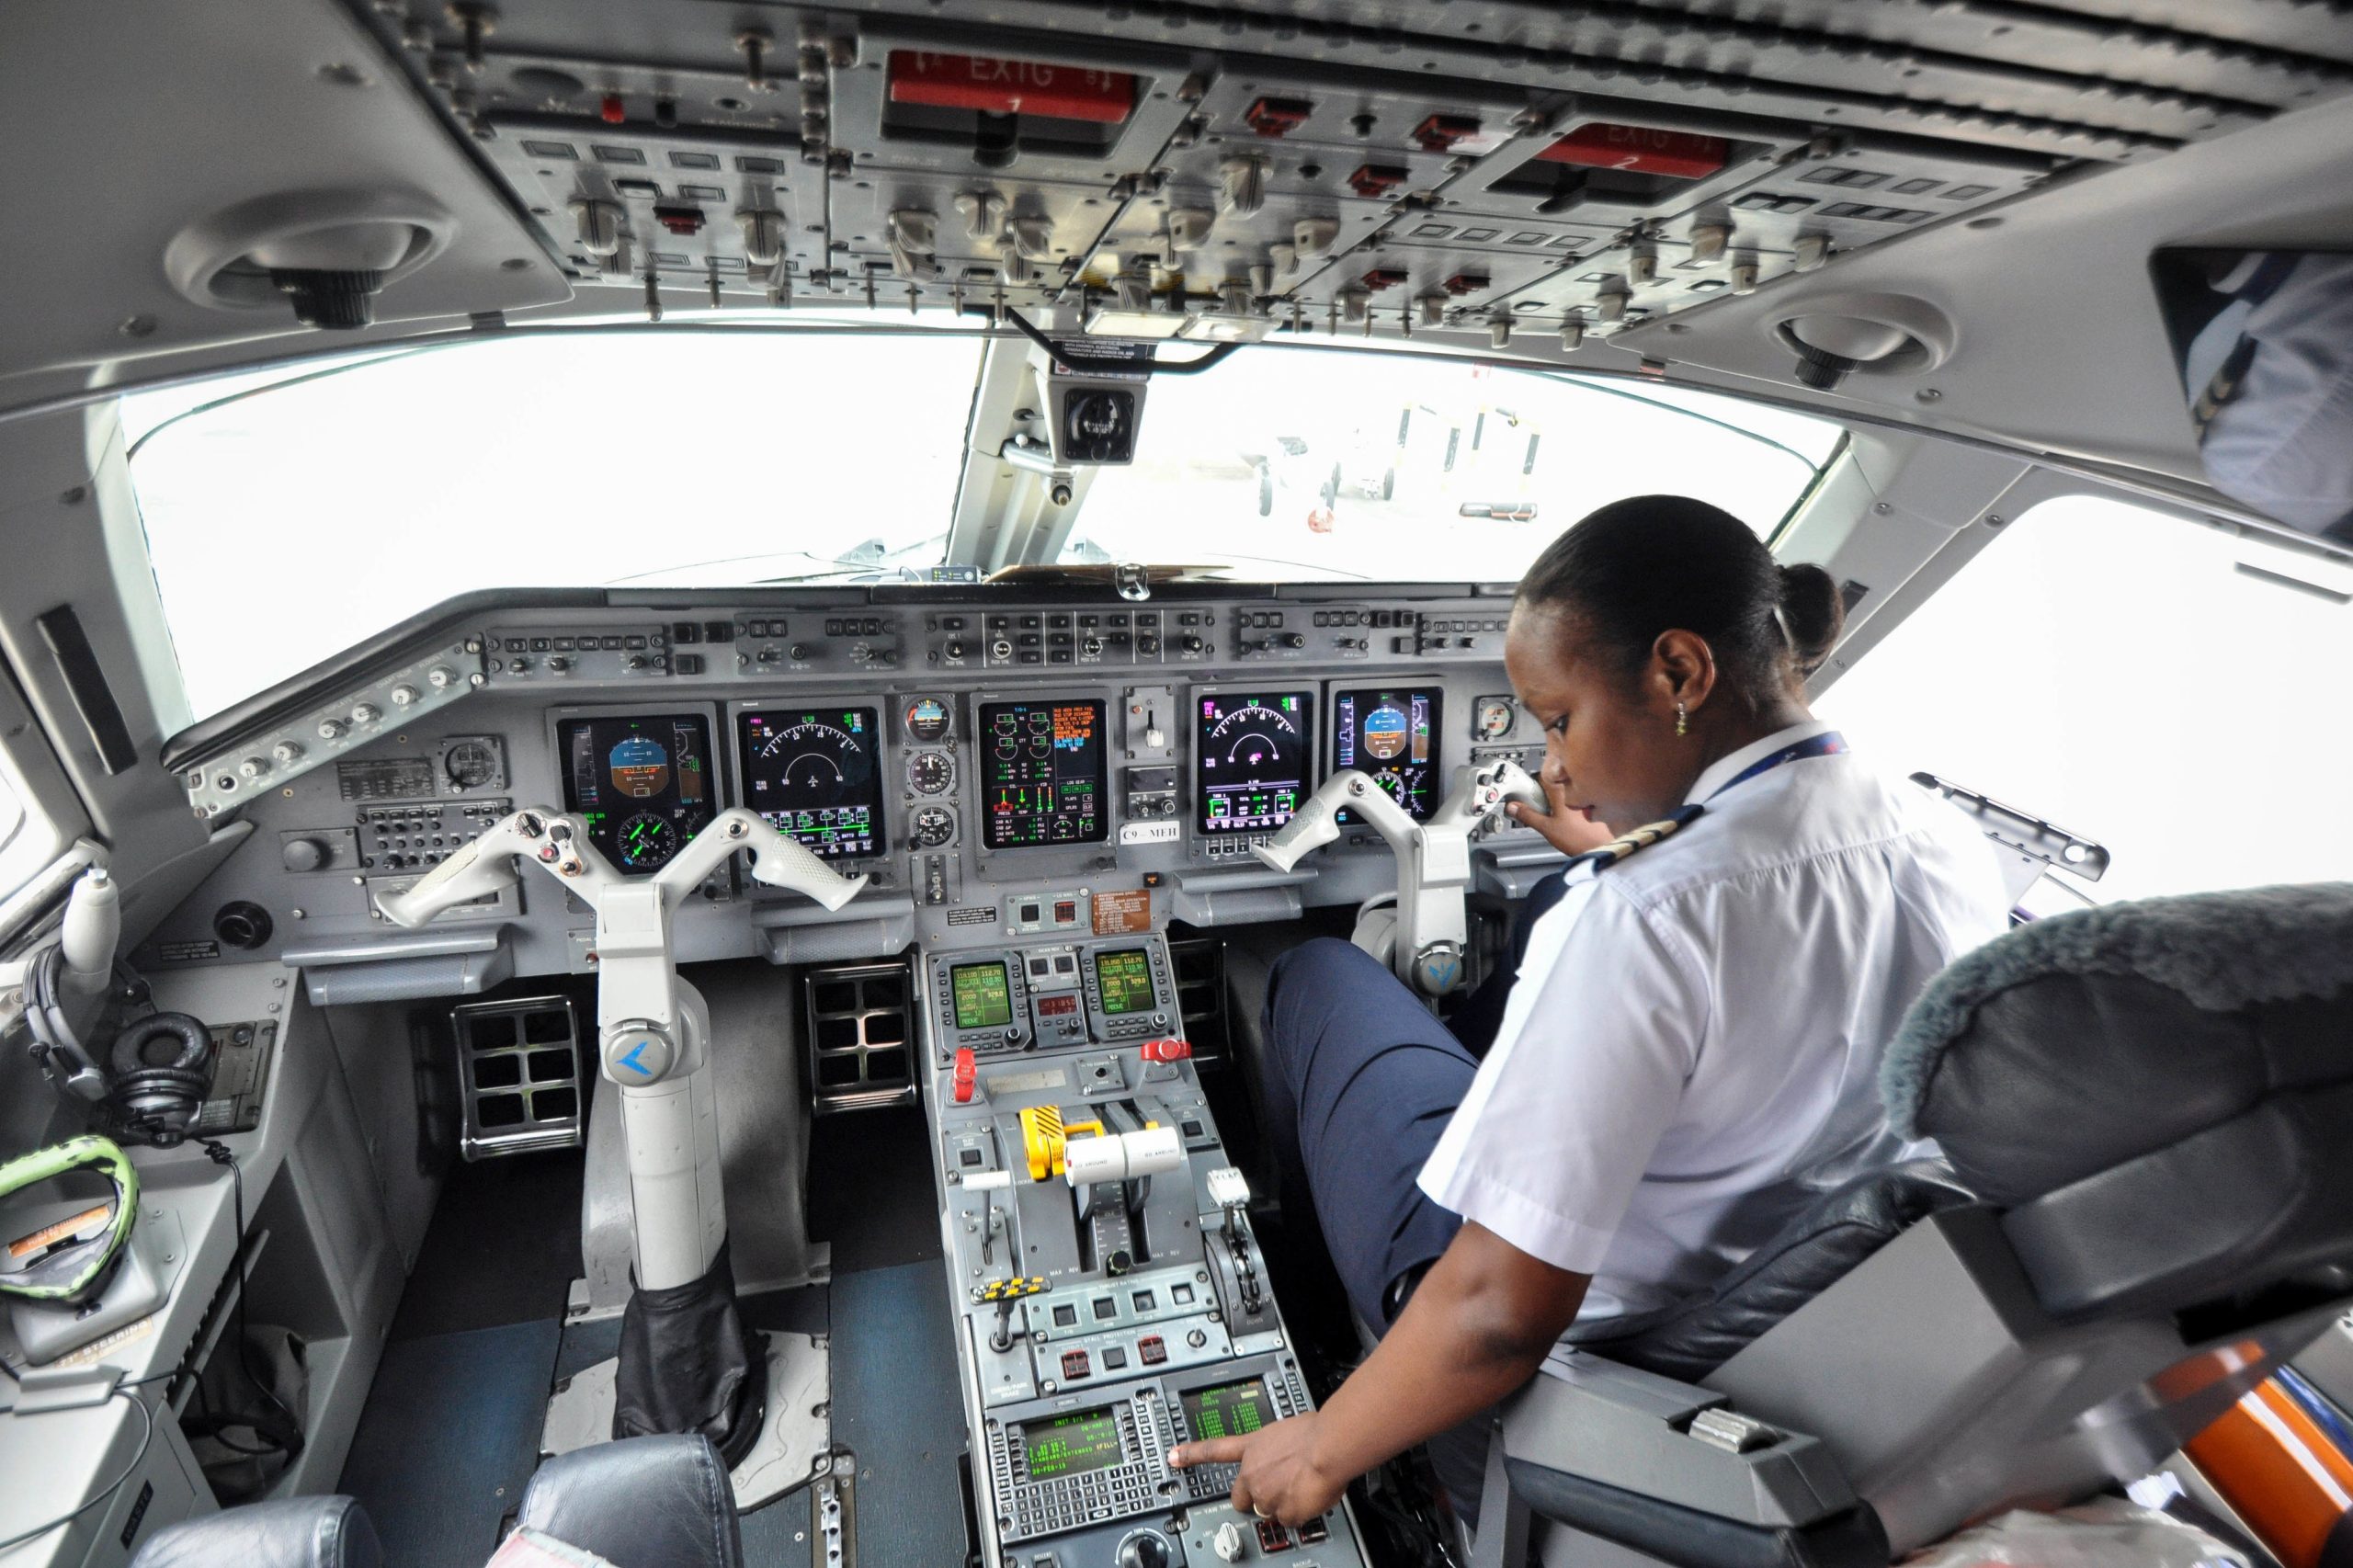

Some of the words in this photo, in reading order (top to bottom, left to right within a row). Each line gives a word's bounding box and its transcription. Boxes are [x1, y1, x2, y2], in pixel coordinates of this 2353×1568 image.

[1123, 830, 1138, 840] C9
[83, 1320, 148, 1356] STEERING
[1054, 1419, 1069, 1427] INIT
